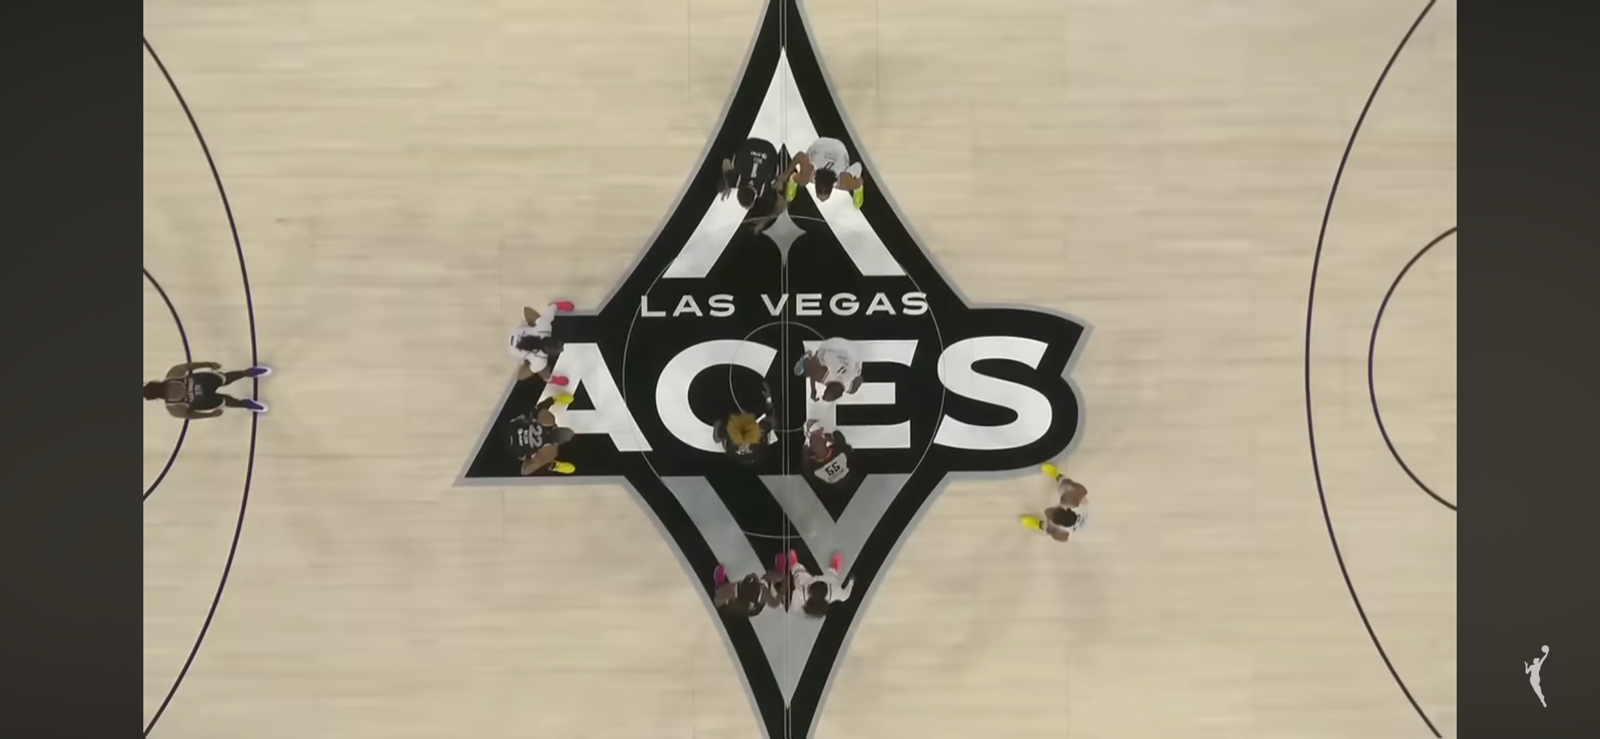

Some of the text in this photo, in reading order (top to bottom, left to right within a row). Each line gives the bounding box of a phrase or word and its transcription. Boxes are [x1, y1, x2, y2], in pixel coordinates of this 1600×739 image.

[641, 291, 930, 318] LAS VEGAS
[530, 335, 1054, 453] ACES
[529, 424, 543, 449] 22
